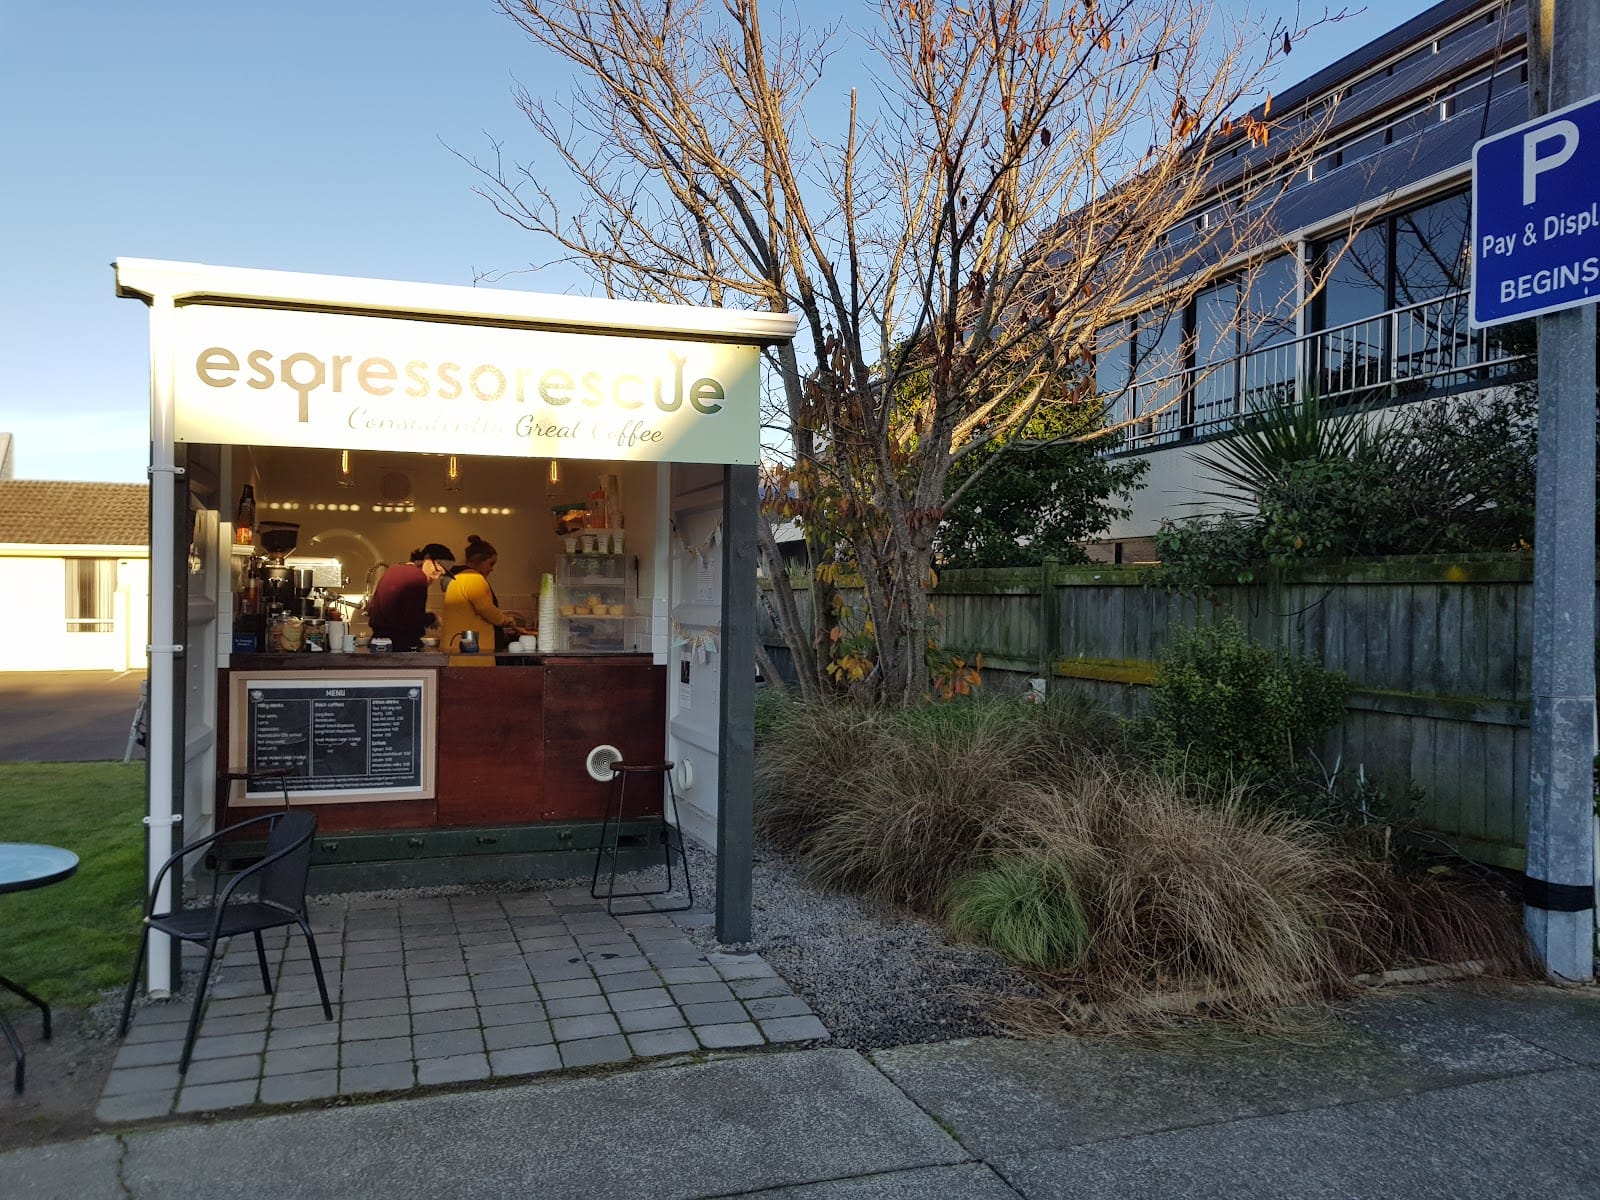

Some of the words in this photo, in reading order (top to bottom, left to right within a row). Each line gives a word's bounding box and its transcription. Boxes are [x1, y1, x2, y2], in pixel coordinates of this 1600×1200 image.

[1523, 119, 1580, 206] P
[1482, 231, 1516, 258] Pay
[1523, 222, 1537, 246] &
[1500, 256, 1600, 304] BEGINS
[515, 414, 578, 441] Great
[591, 418, 665, 447] Coffee
[325, 689, 346, 697] MENU
